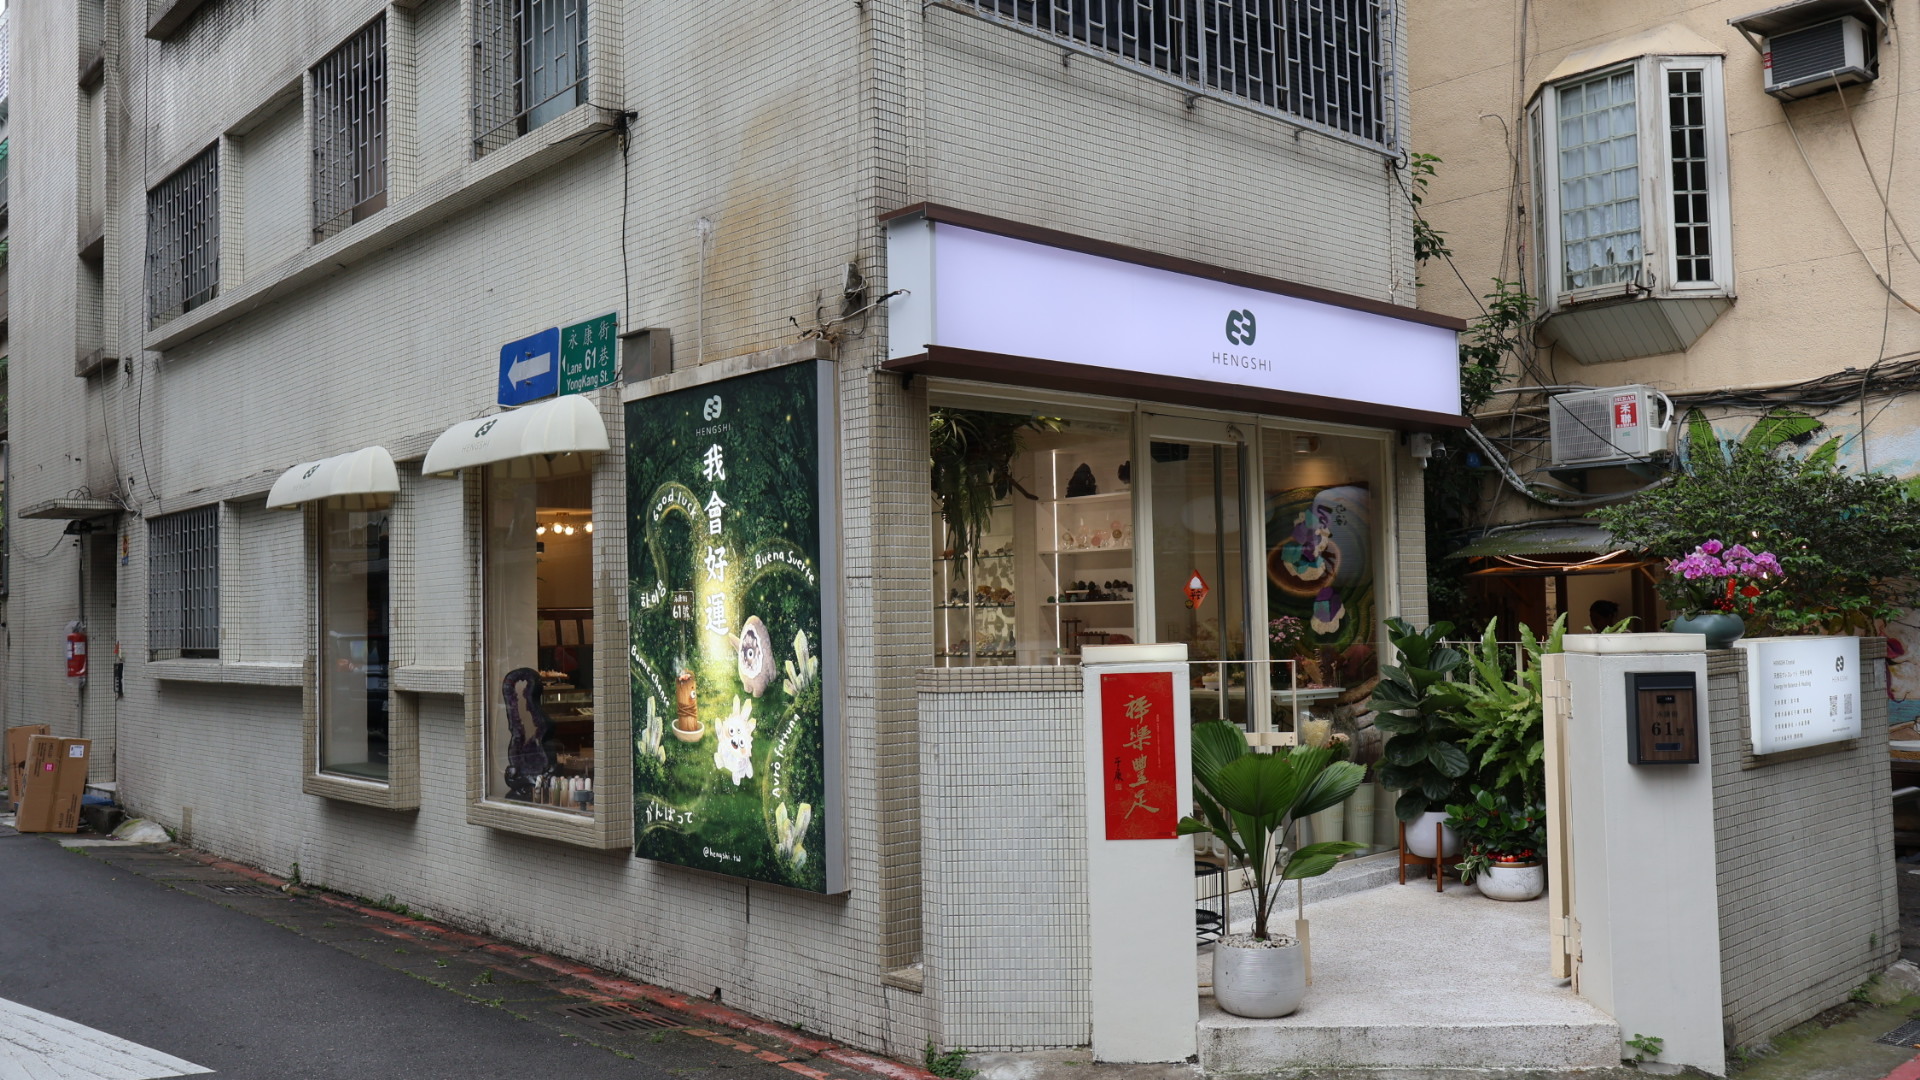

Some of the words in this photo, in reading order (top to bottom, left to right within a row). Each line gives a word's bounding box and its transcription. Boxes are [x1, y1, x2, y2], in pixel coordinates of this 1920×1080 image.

[568, 320, 609, 350] 永康街
[567, 362, 582, 375] Lane
[585, 347, 597, 370] 61
[1212, 352, 1272, 371] HENGSHI
[567, 374, 599, 391] YongKang
[600, 369, 608, 383] St.
[695, 422, 731, 437] HENGSHI
[677, 491, 697, 520] luck
[703, 443, 729, 636] 我會好運
[755, 551, 785, 569] Buena
[787, 550, 815, 586] Suerte
[631, 644, 651, 676] Bonne
[774, 713, 801, 758] fortuna
[772, 761, 781, 798] Avrò
[702, 846, 741, 863] @hengshi.tw
